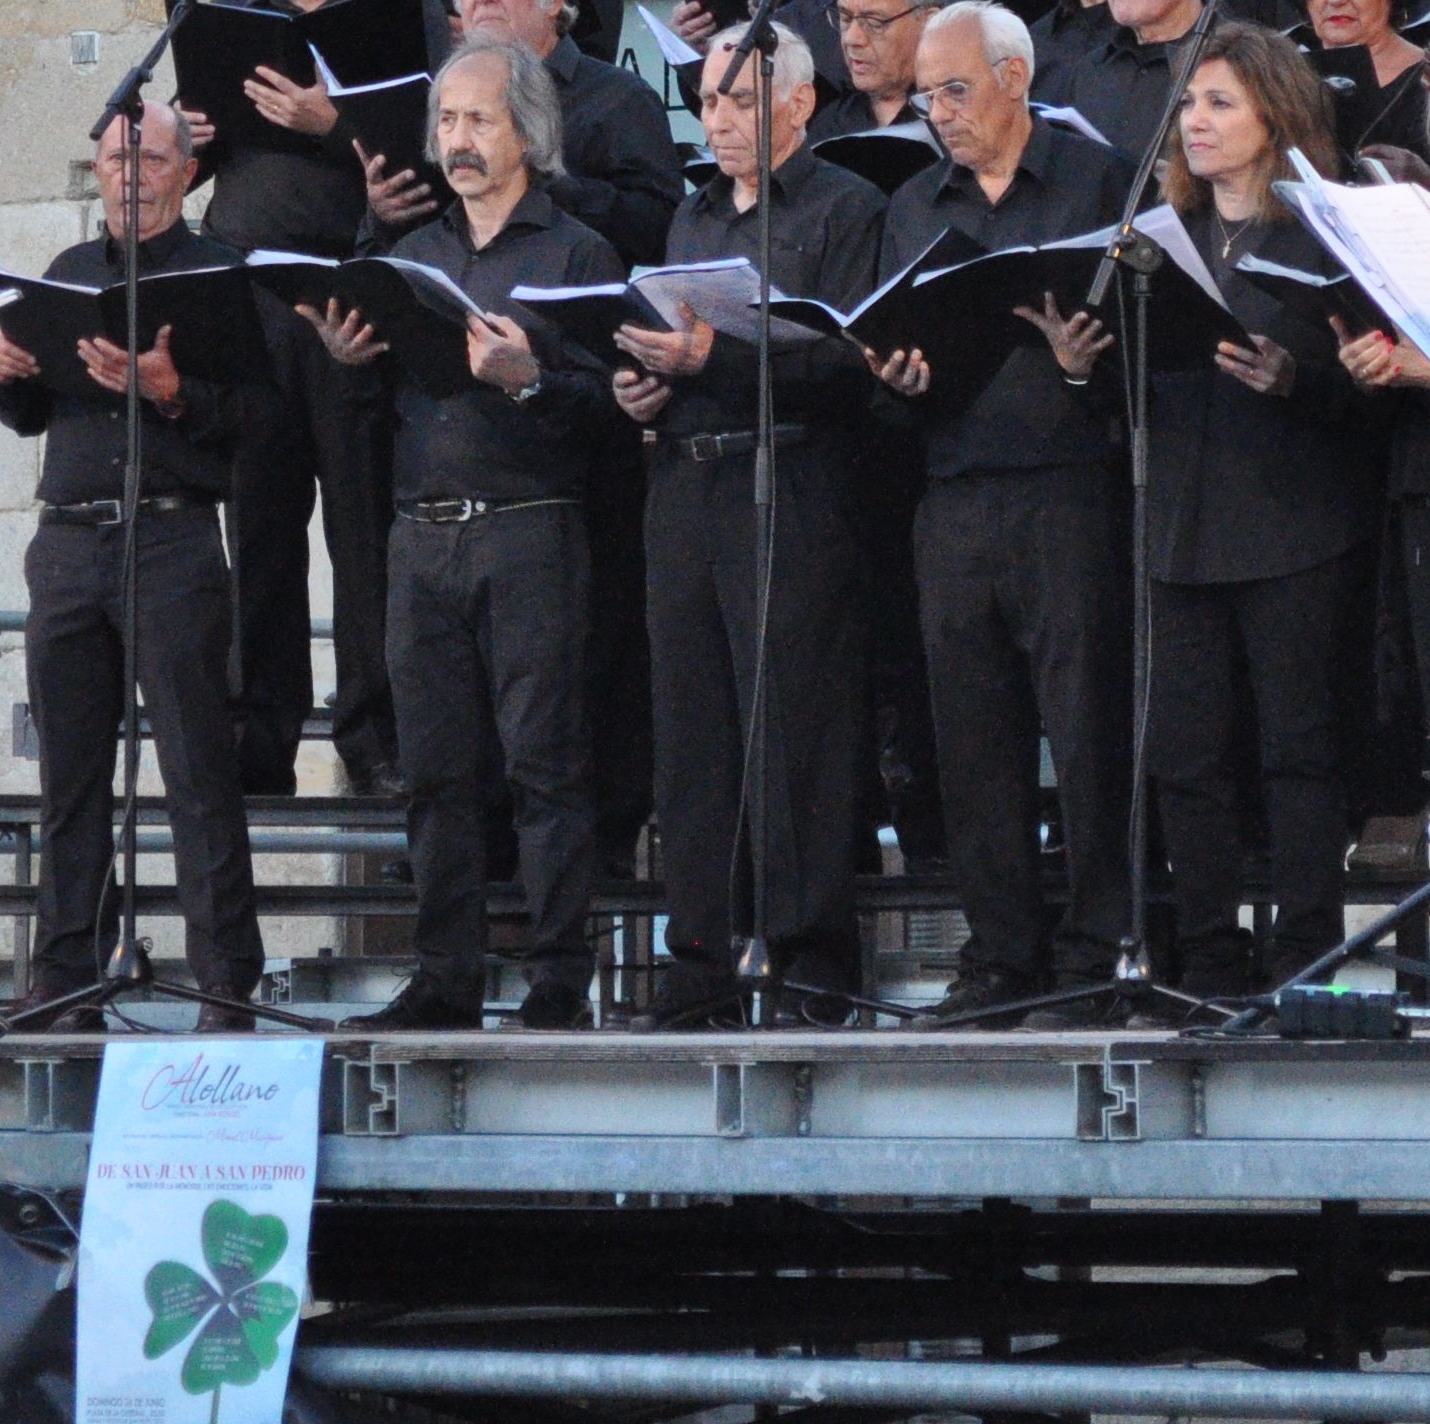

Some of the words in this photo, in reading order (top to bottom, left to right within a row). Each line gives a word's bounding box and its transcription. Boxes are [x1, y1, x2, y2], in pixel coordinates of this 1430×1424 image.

[97, 1163, 117, 1179] DE
[121, 1163, 153, 1179] SAN
[157, 1164, 198, 1180] JUAN
[201, 1164, 213, 1180] A
[216, 1164, 248, 1180] SAN
[251, 1164, 306, 1181] PEDRO
[87, 1397, 122, 1407] DOMINGO
